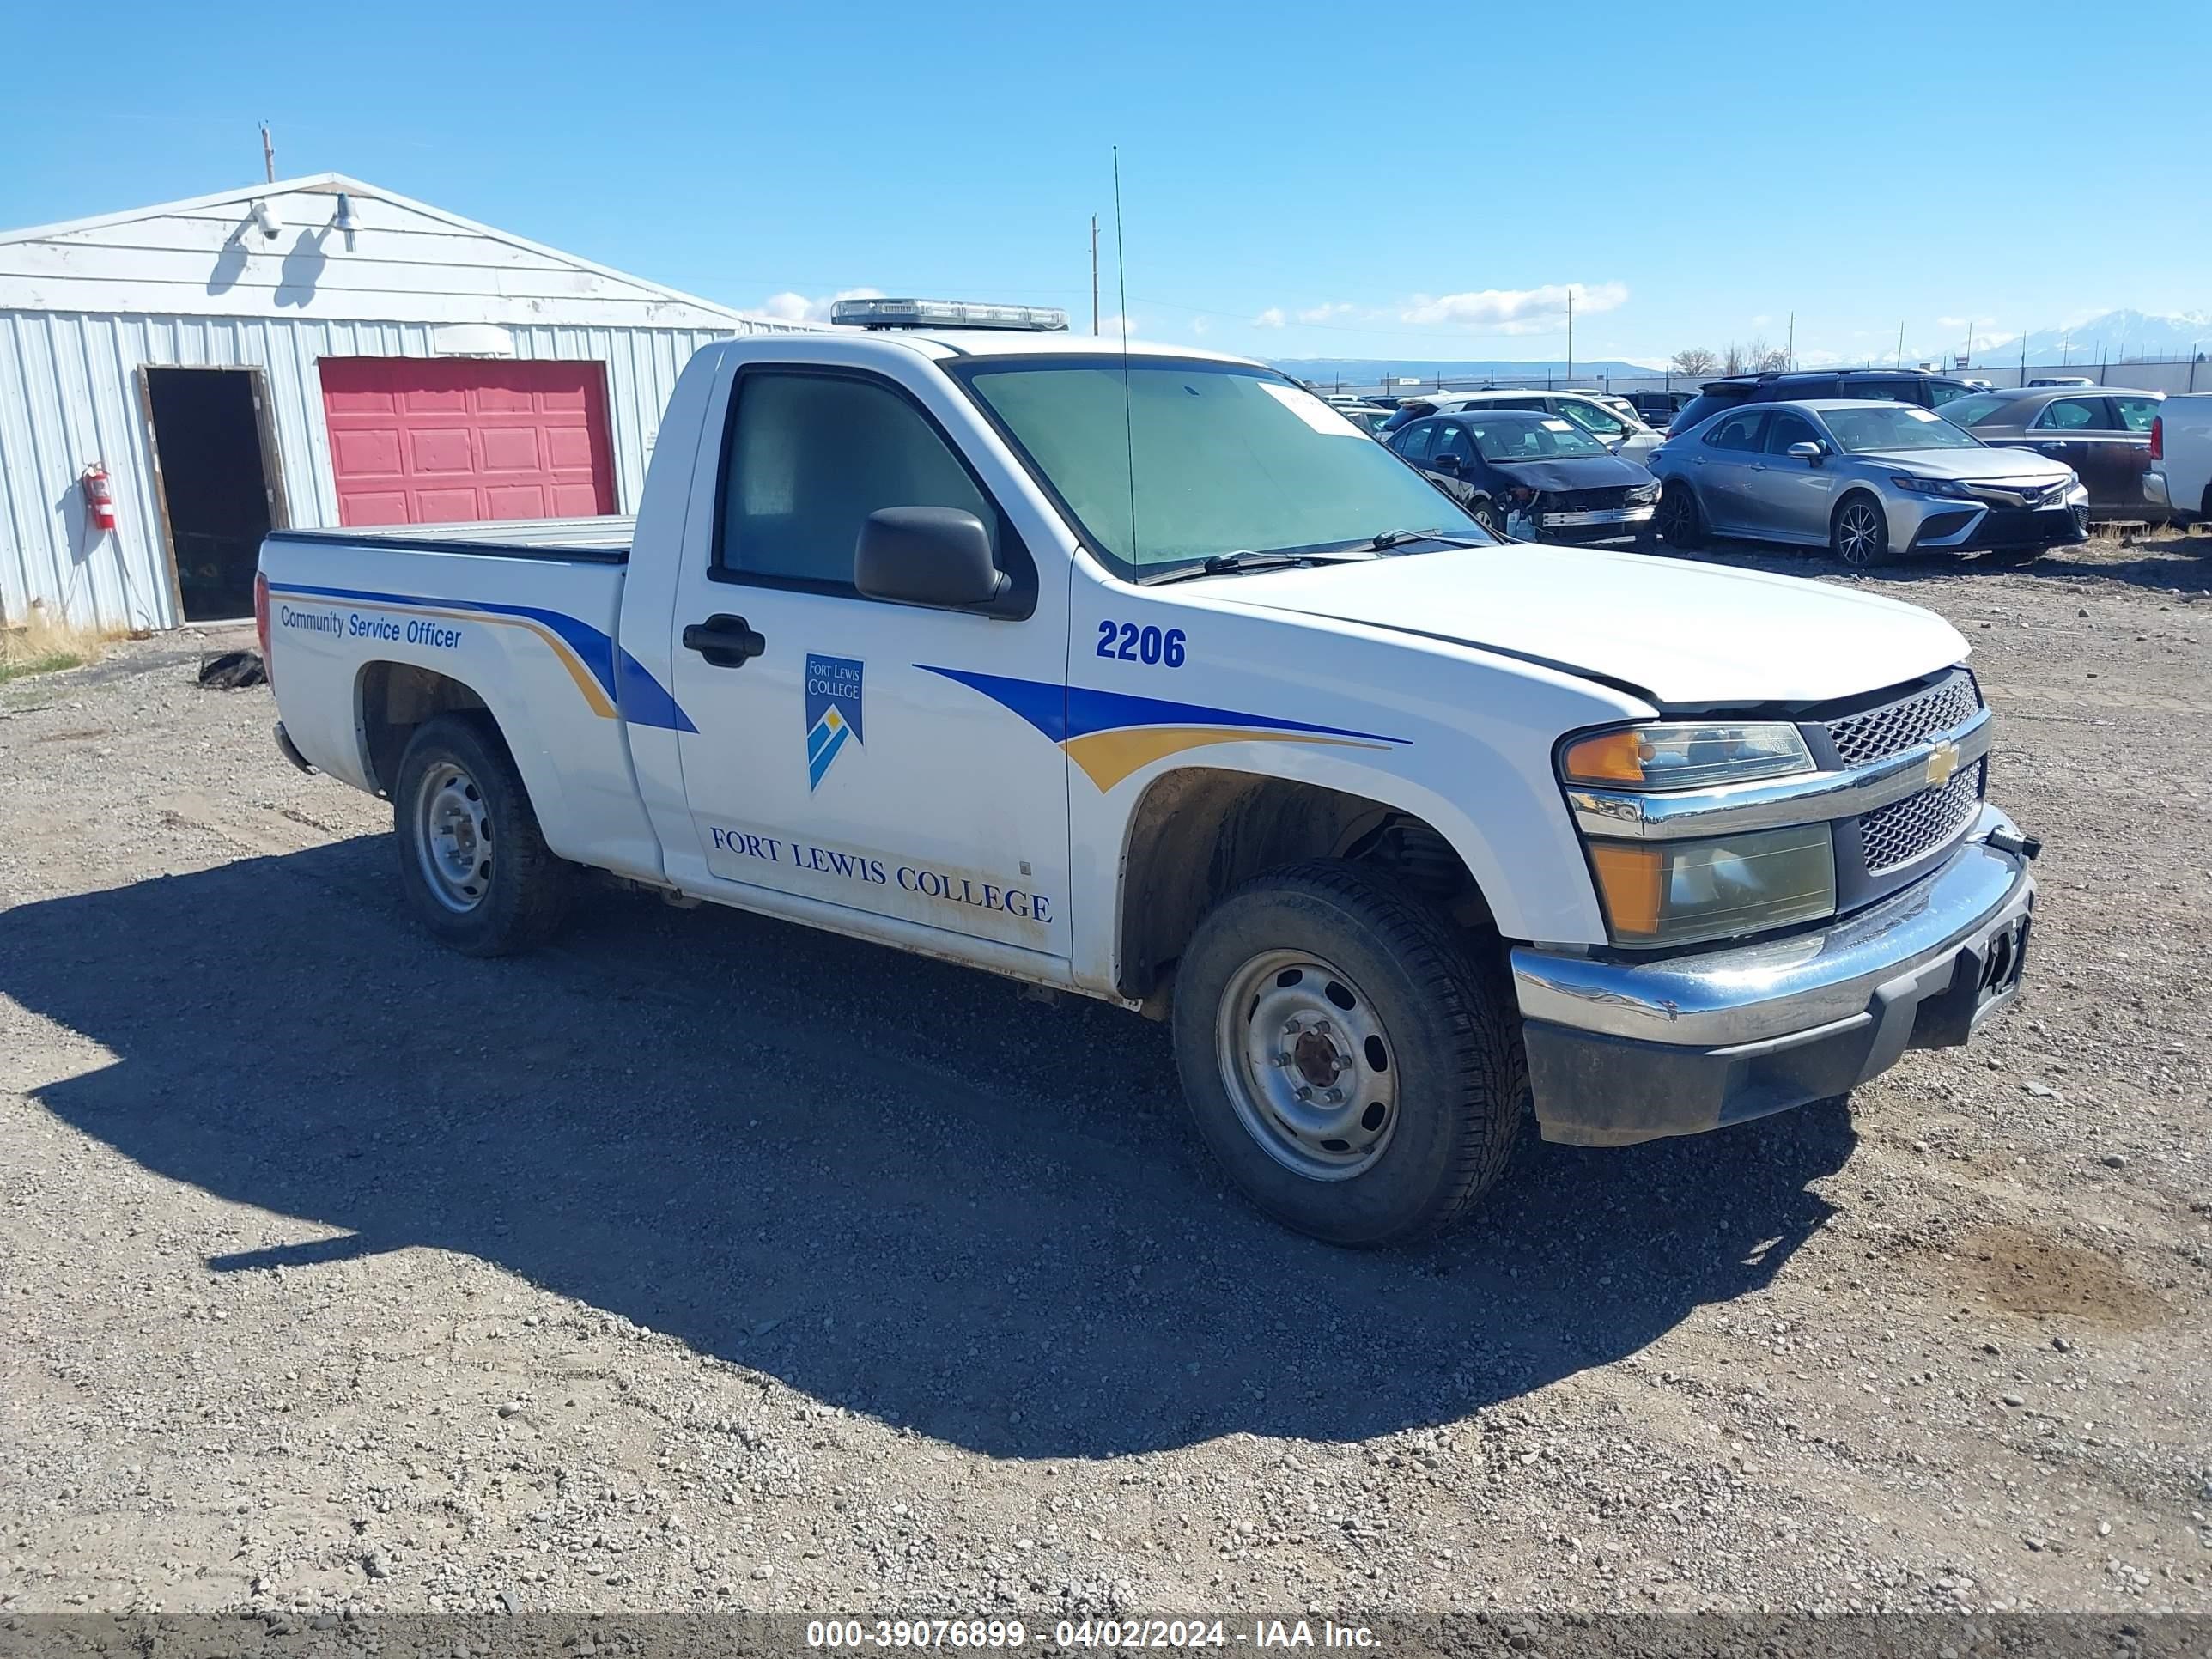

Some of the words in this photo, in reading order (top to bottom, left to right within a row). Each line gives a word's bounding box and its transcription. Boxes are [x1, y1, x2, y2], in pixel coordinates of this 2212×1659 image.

[281, 605, 344, 638] Community
[349, 613, 400, 641] Service
[407, 620, 462, 649] Officer
[1097, 620, 1187, 668] 2206
[808, 678, 860, 700] COLLEGE
[810, 660, 832, 678] FORT
[834, 664, 860, 681] LEWIS
[709, 826, 782, 862] FORT
[790, 843, 887, 885] LEWIS
[896, 866, 1054, 924] COLLEGE
